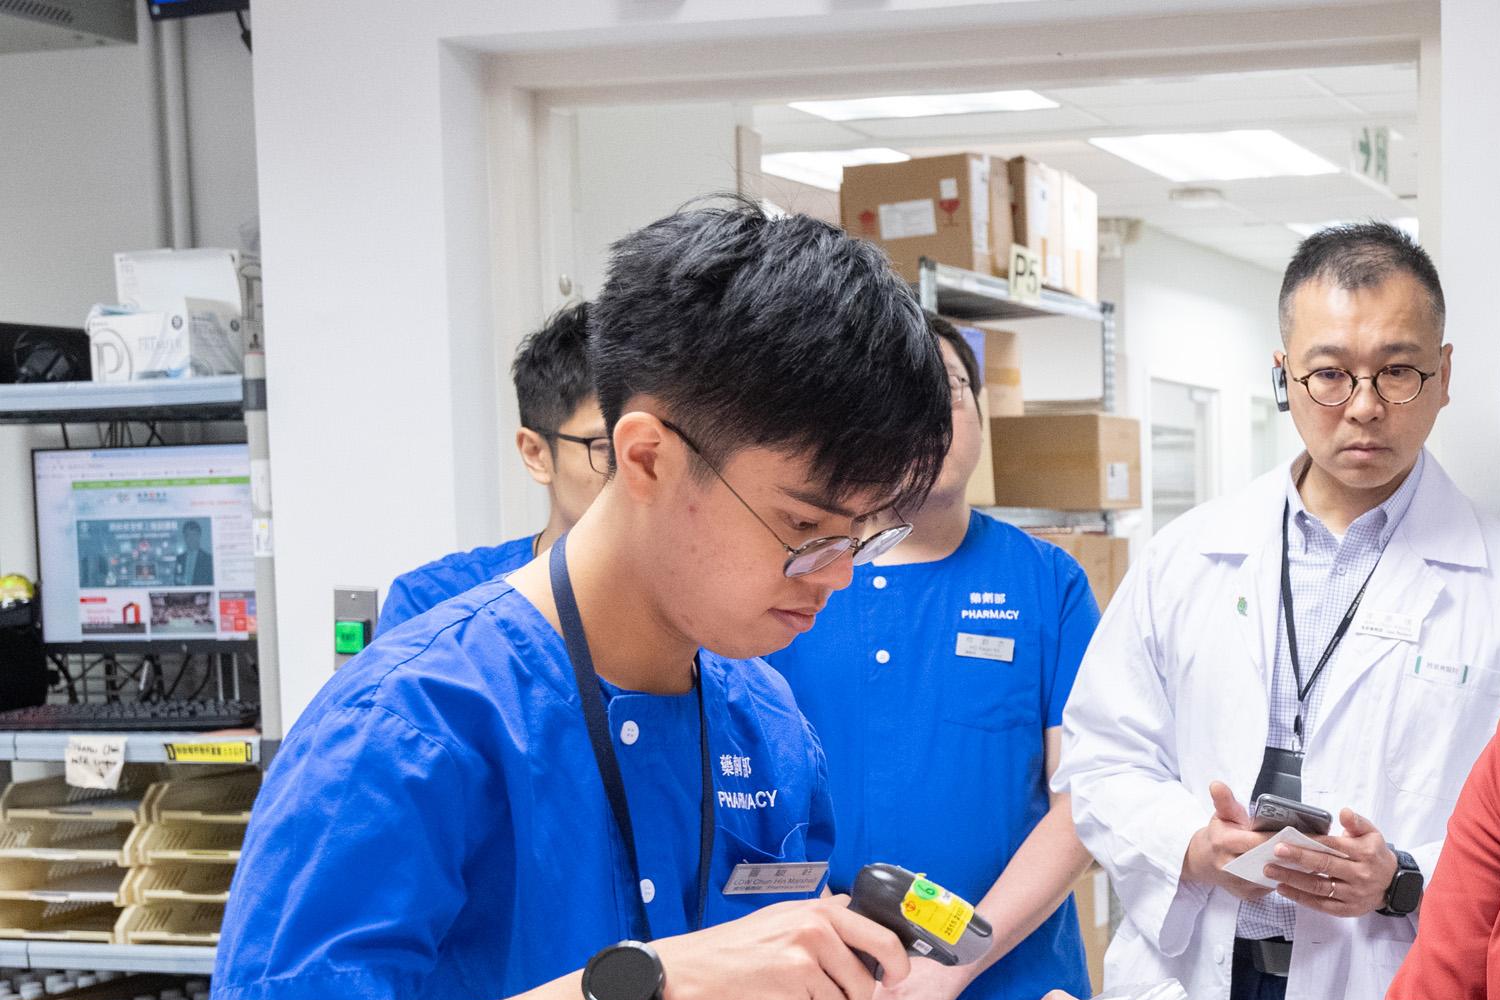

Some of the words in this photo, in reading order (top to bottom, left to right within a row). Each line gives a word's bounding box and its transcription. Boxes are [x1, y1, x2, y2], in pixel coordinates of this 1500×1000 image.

[1014, 253, 1037, 294] P5
[961, 609, 1020, 620] PHARMACY
[718, 789, 778, 810] PHARMACY
